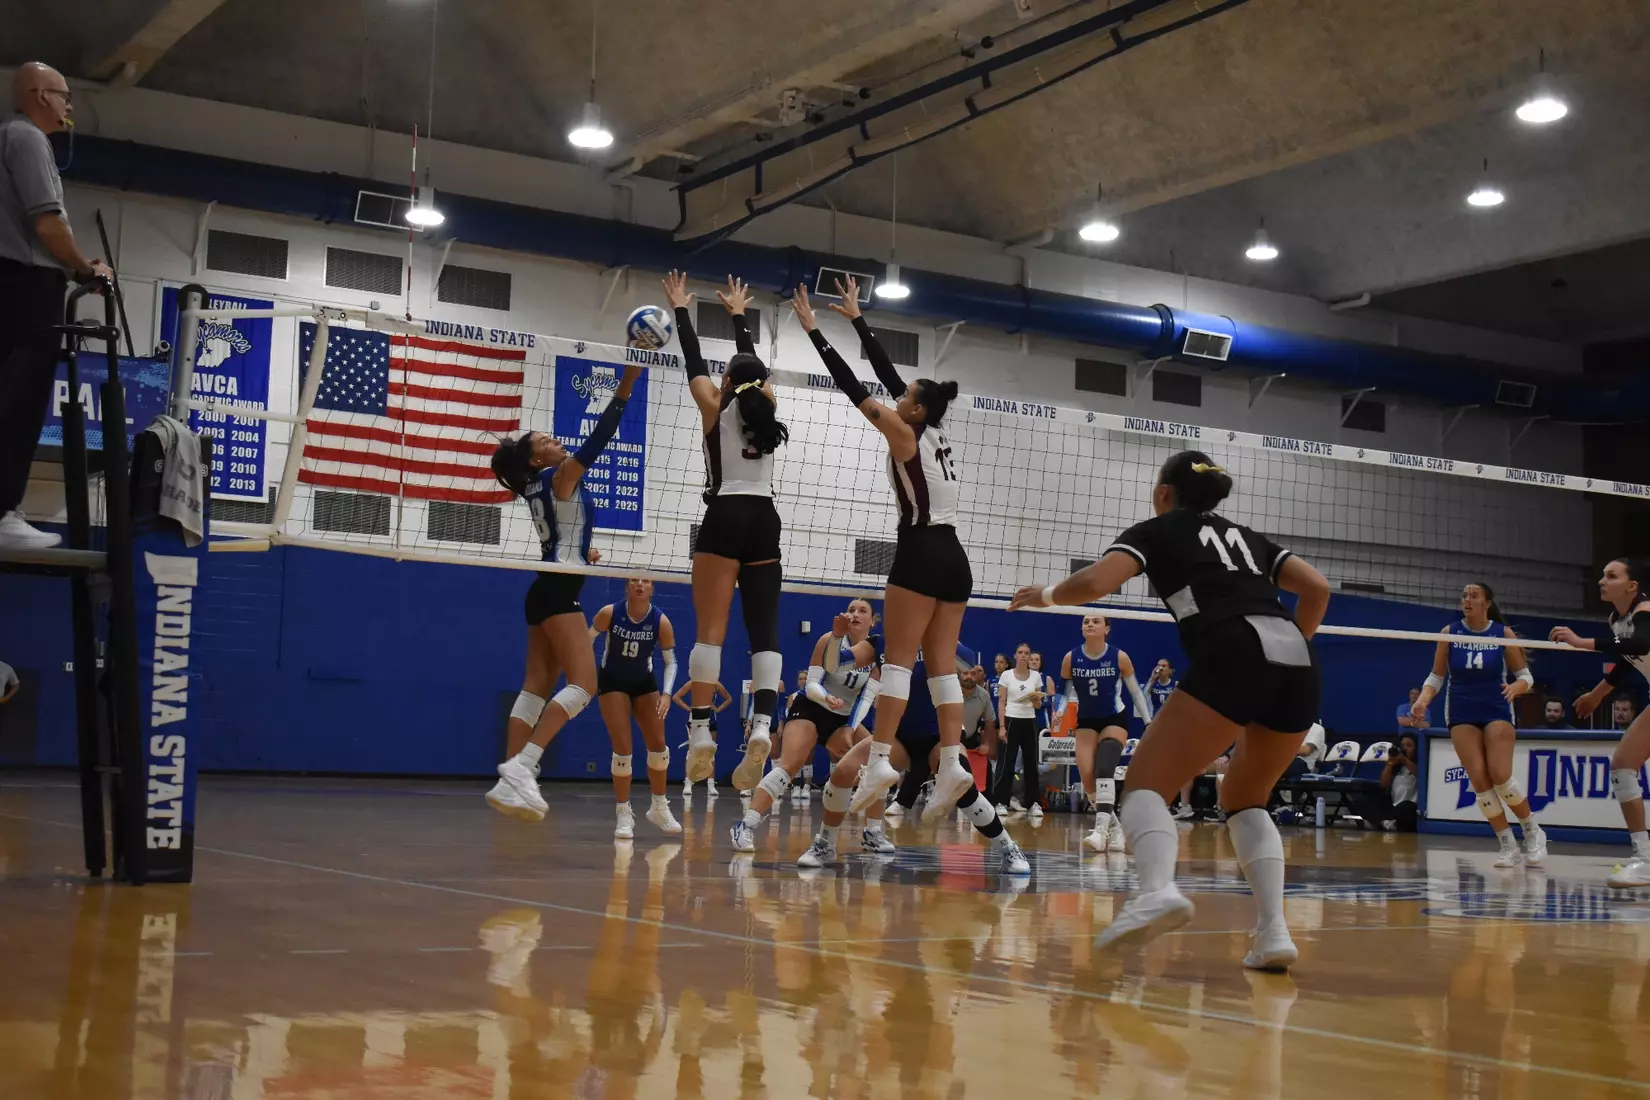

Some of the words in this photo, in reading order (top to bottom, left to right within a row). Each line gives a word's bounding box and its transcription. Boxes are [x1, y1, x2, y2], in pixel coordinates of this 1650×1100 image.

[196, 323, 251, 353] ycamores
[425, 320, 484, 341] INDIANA
[490, 329, 535, 348] STATE
[625, 348, 679, 368] INDIANA
[191, 372, 238, 396] AVCA
[571, 373, 620, 398] Sycamo
[192, 393, 231, 407] CADEMIC
[232, 398, 265, 412] AWARD
[973, 396, 1018, 414] INDIANA
[1022, 403, 1056, 419] STATE
[231, 430, 259, 443] 2004
[1124, 417, 1164, 434] INDIANA
[1169, 423, 1200, 438] STATE
[231, 446, 258, 459] 2007
[616, 442, 643, 454] AWARD
[1262, 435, 1300, 452] INDIANA
[1303, 440, 1333, 456] STATE
[230, 462, 257, 475] 2010
[617, 456, 639, 468] 2016
[1389, 452, 1424, 468] INDIANA
[1426, 457, 1453, 472] STATE
[229, 478, 256, 491] 2013
[617, 470, 639, 482] 2019
[1505, 468, 1538, 483] INDIANA
[1540, 472, 1565, 486] STATE
[588, 482, 610, 494] 2021
[615, 485, 639, 497] 2022
[1613, 481, 1643, 496] INDIANA
[615, 500, 638, 511] 2025
[1198, 525, 1263, 576] 11
[144, 551, 198, 727] INDIANA
[612, 624, 654, 641] SYCAMORES
[621, 640, 640, 658] 19
[1466, 651, 1484, 670] 14
[1072, 667, 1116, 678] SYCAMORES
[1089, 678, 1099, 696] 2
[147, 735, 187, 850] STATE
